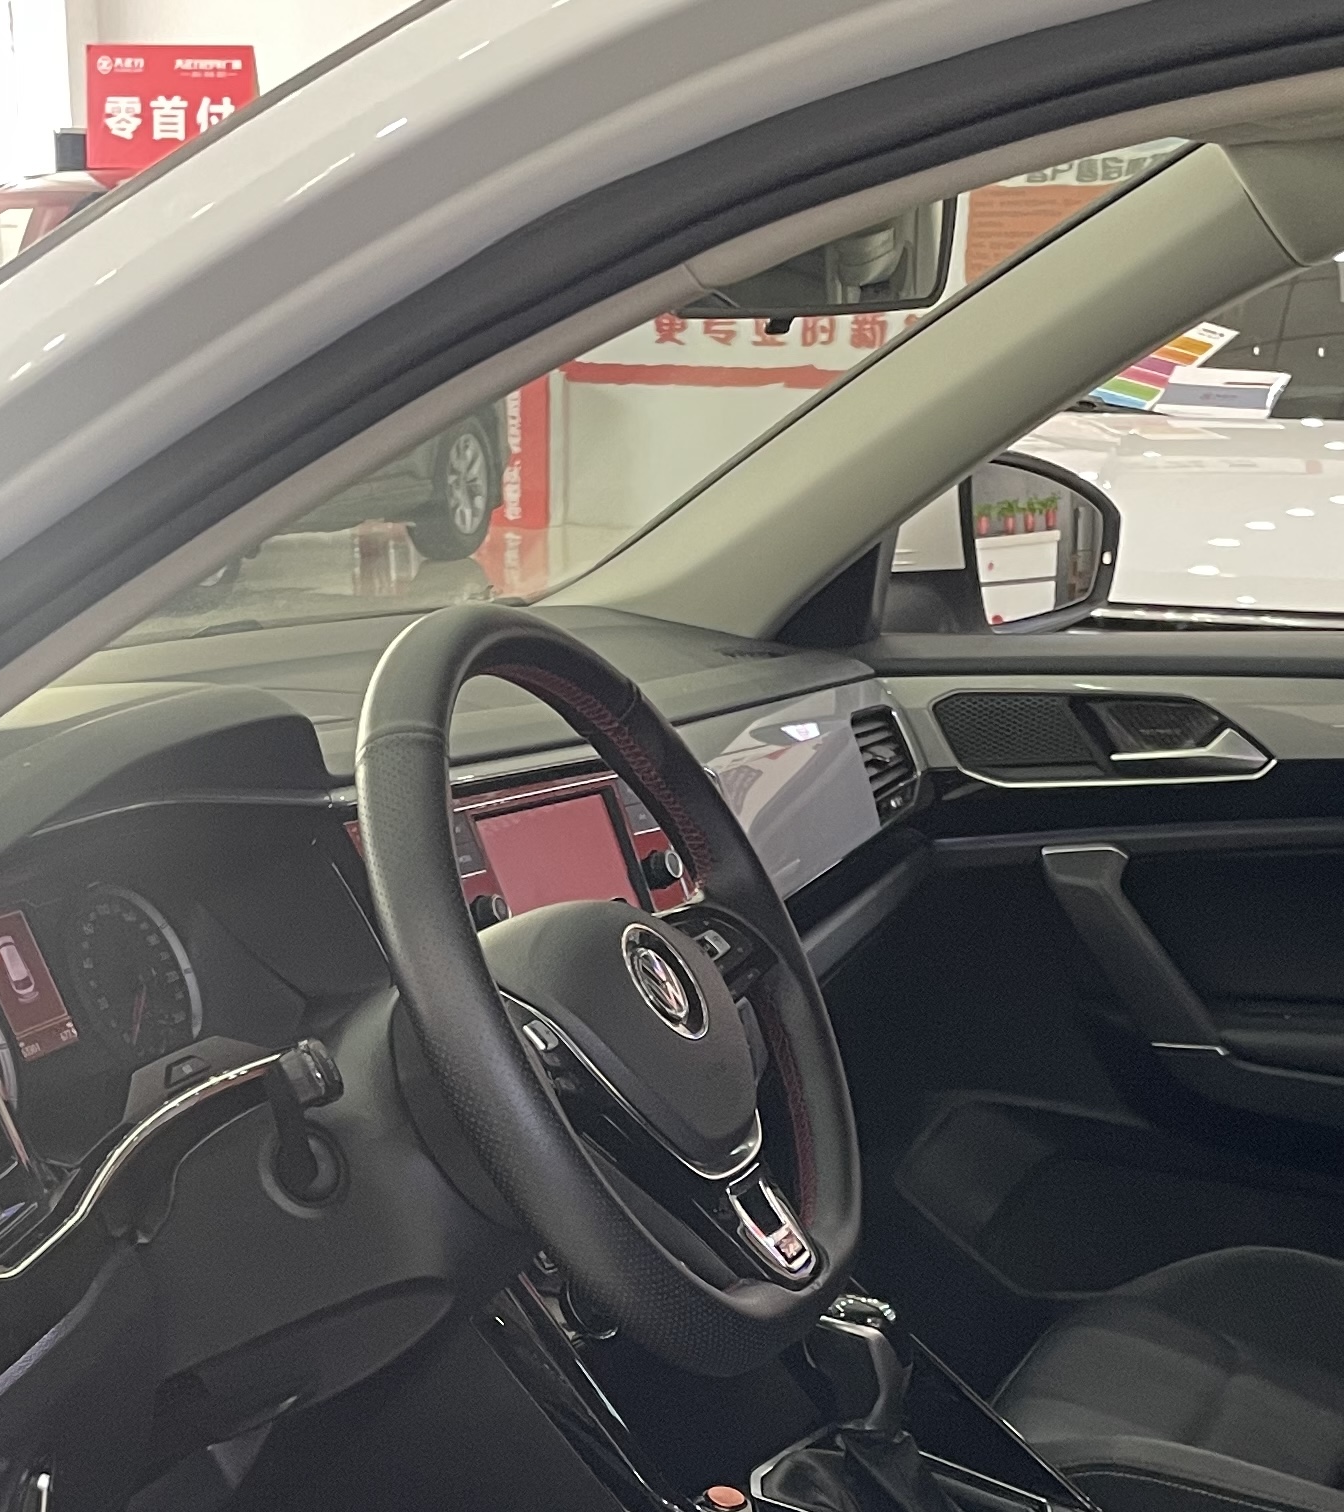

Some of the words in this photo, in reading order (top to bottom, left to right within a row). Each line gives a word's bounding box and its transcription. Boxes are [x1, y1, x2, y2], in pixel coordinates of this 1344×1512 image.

[104, 95, 236, 141] 零首付
[654, 312, 918, 350] 更专业的新
